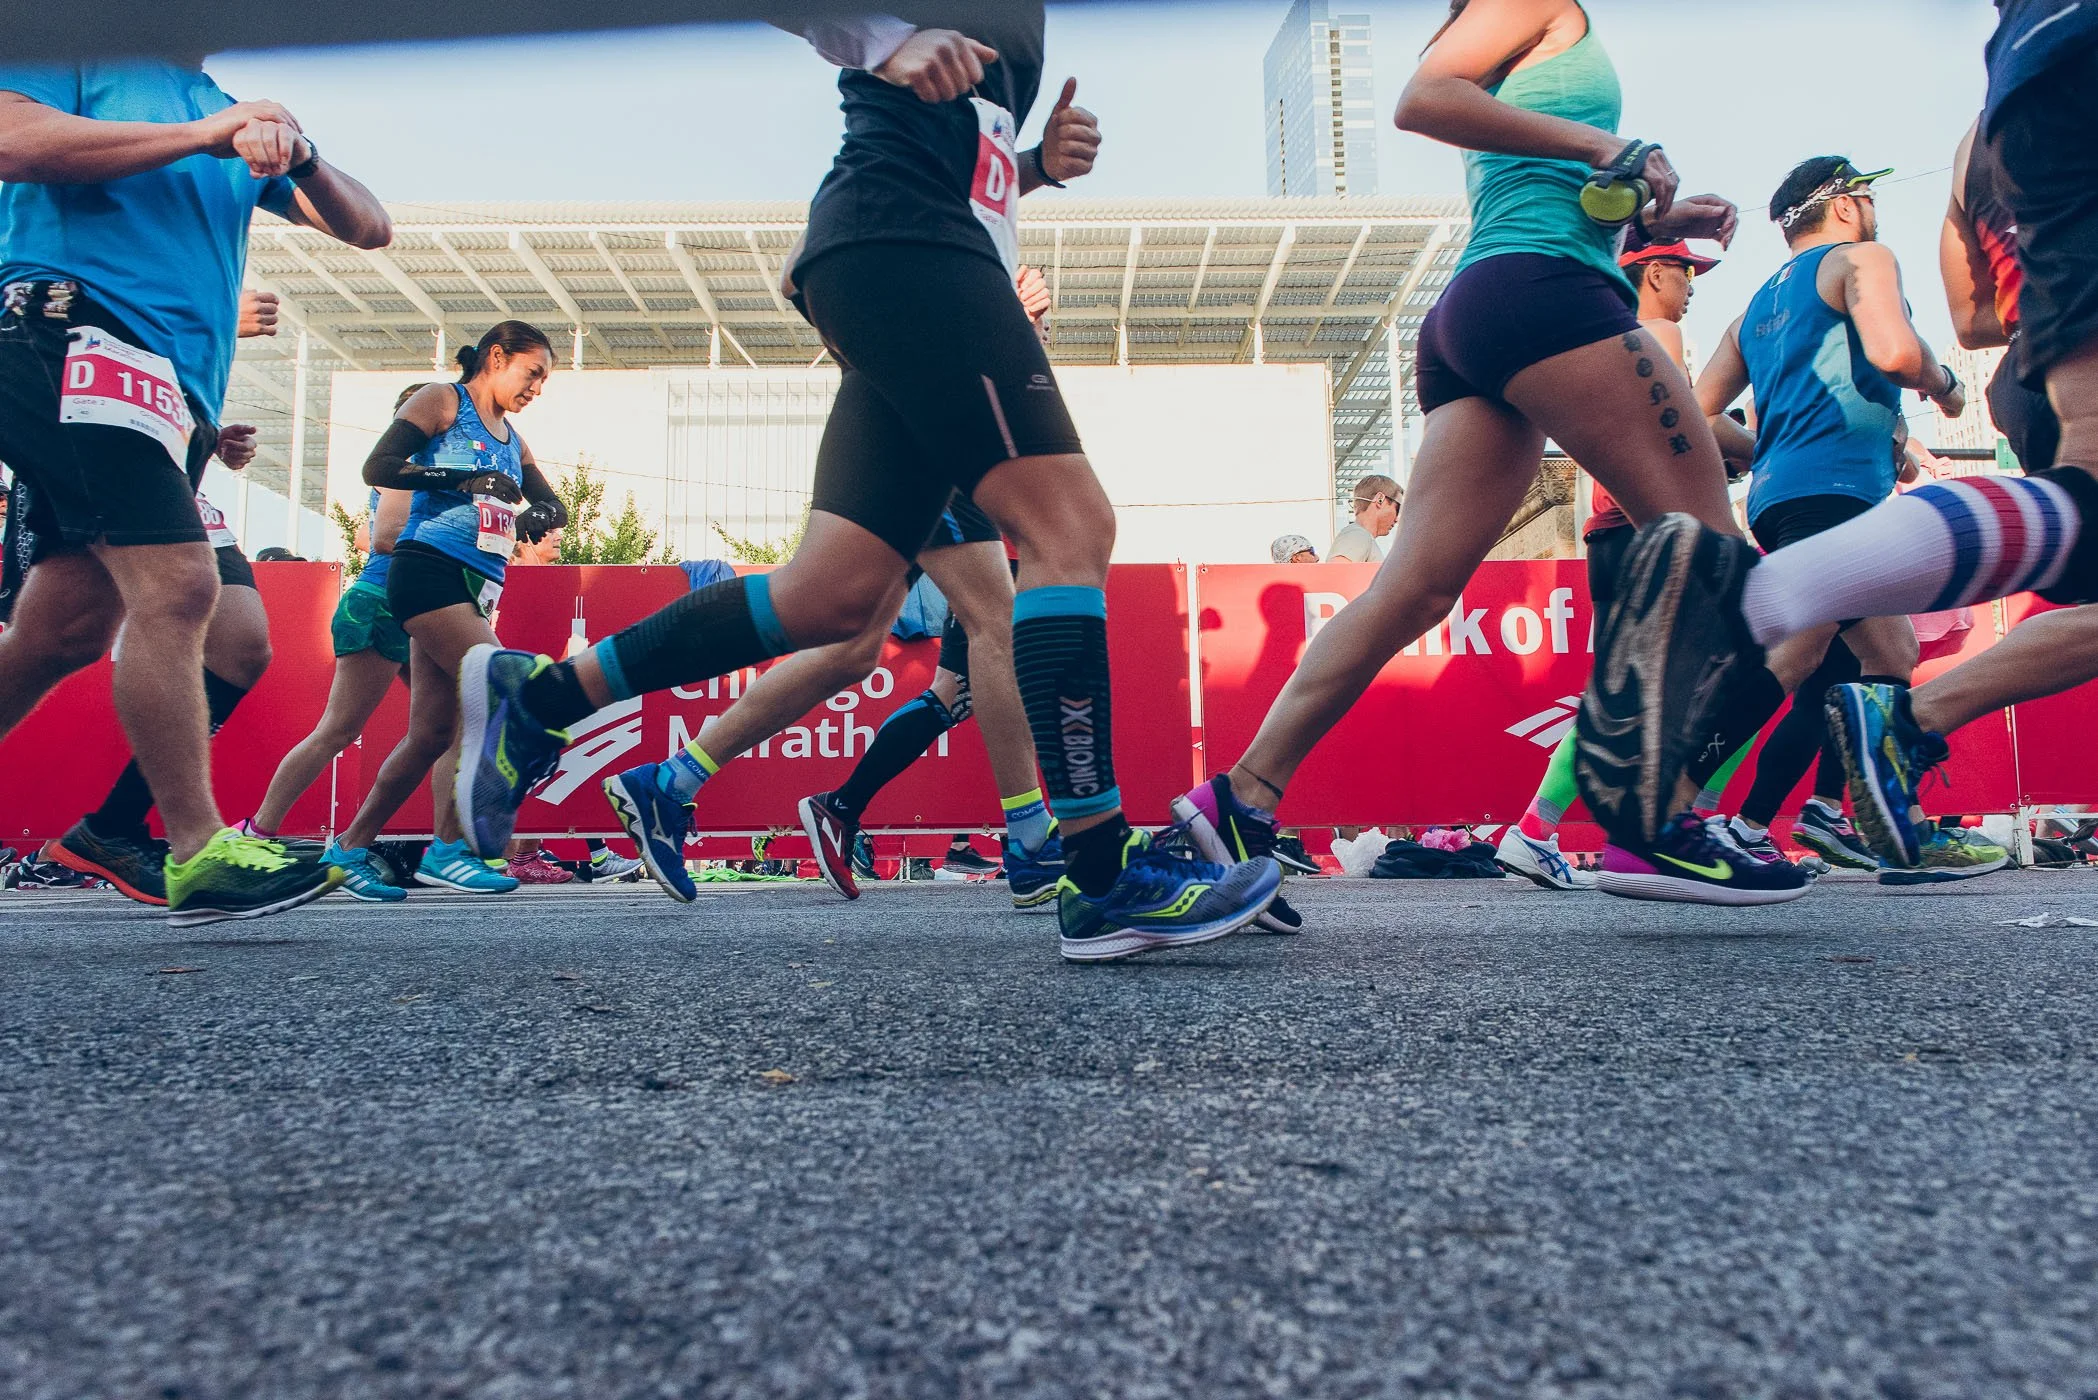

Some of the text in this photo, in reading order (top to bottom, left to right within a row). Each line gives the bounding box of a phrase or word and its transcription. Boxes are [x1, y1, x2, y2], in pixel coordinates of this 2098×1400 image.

[986, 154, 1005, 202] D
[69, 360, 95, 390] D
[482, 507, 492, 528] D
[1303, 592, 1493, 656] Bnk
[1500, 588, 1575, 656] of
[668, 714, 949, 759] Mrathn
